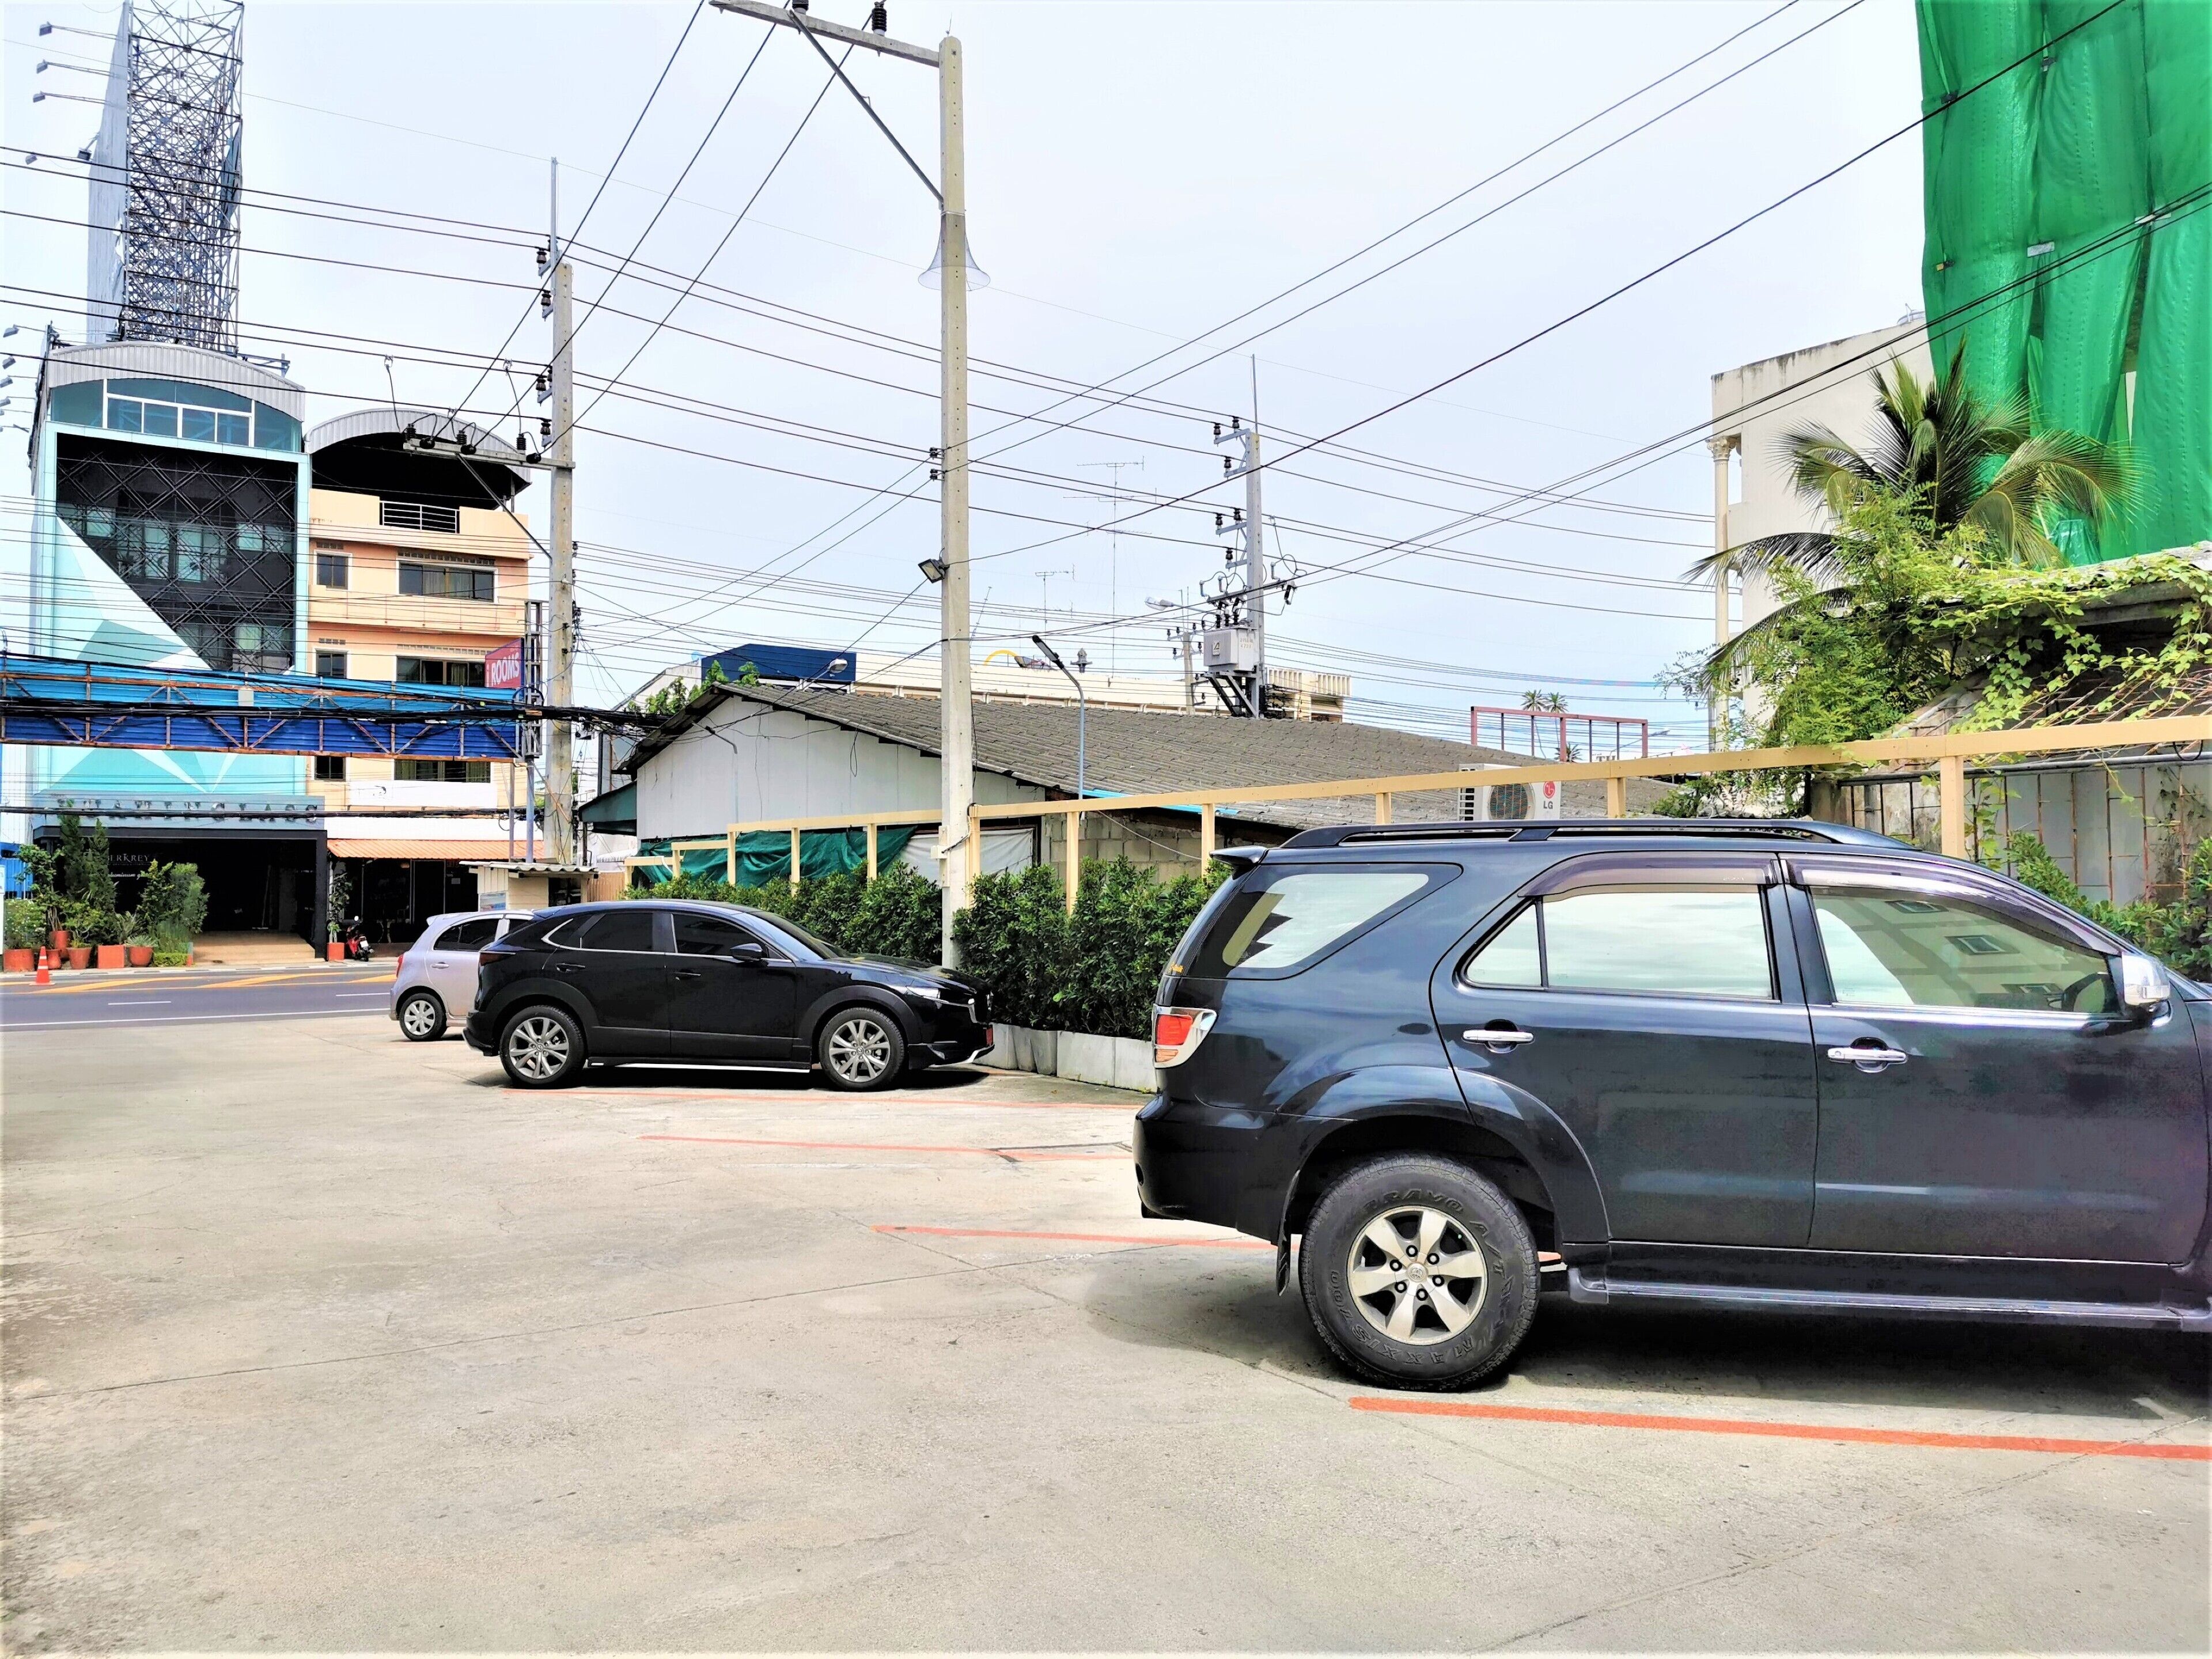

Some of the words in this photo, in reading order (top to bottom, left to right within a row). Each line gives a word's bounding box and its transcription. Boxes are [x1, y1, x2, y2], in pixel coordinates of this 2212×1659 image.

[491, 652, 520, 687] ROOMS
[1543, 800, 1554, 809] LG
[1351, 1323, 1474, 1365] MAXXIS
